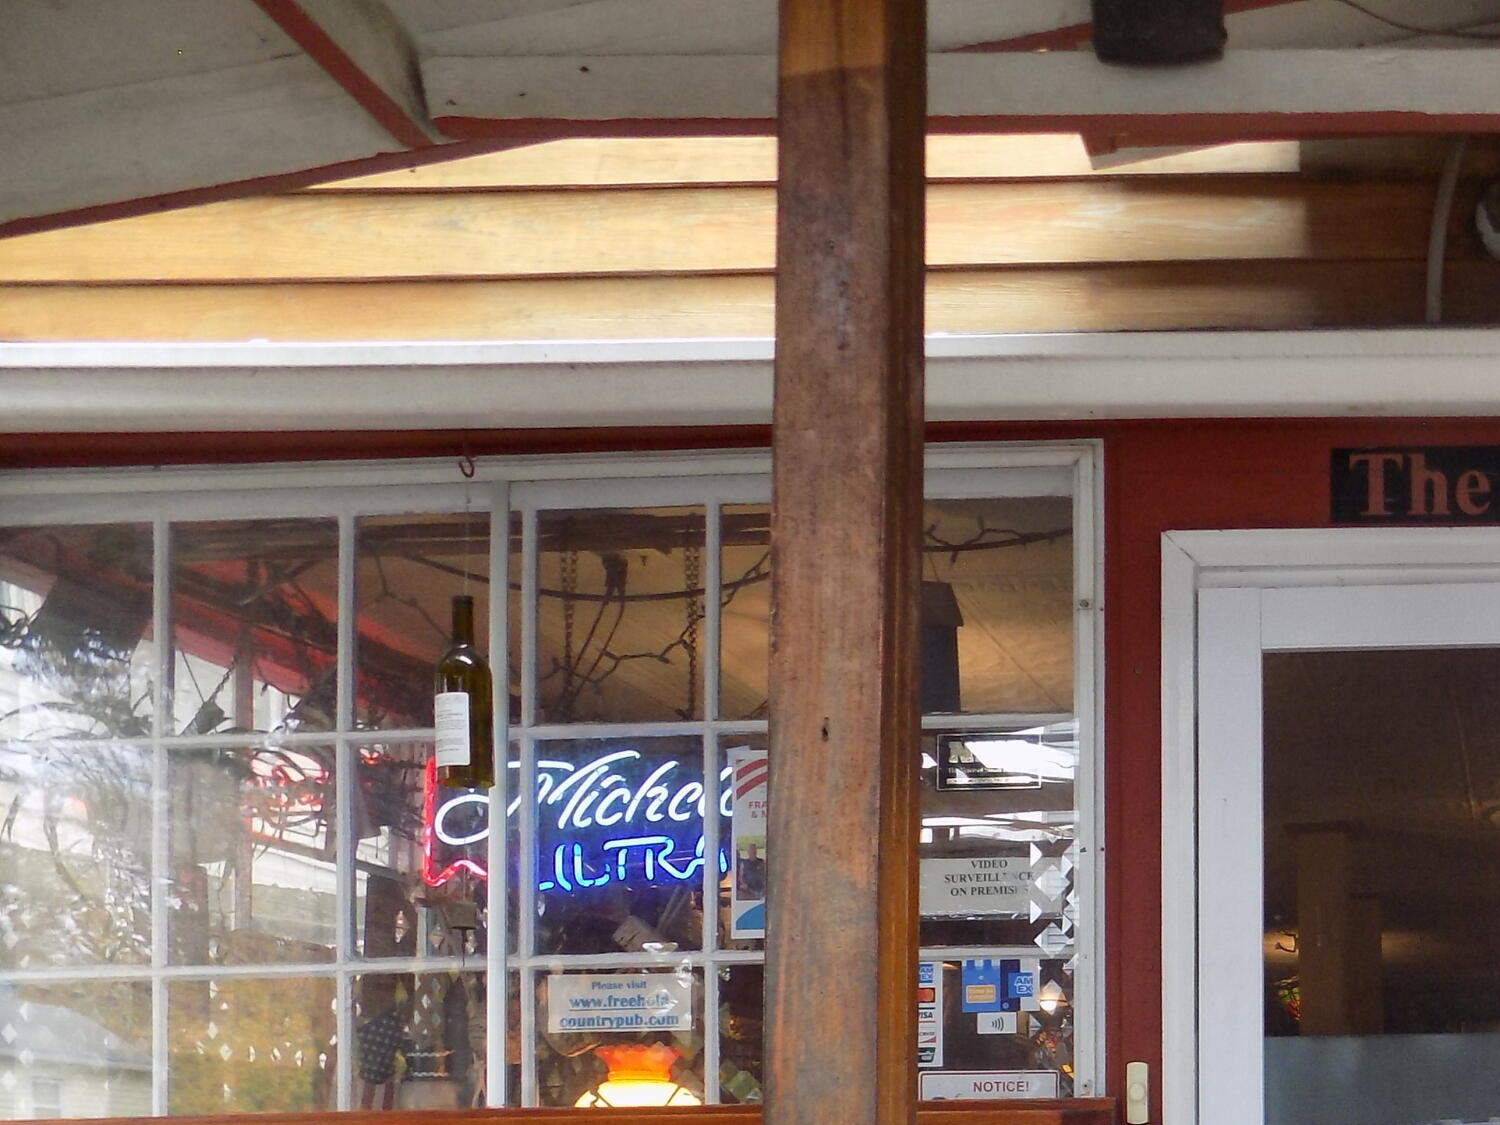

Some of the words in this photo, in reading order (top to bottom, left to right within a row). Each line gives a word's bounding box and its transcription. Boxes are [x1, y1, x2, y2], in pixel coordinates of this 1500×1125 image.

[1350, 453, 1491, 516] The
[971, 859, 1008, 869] VIDEO
[944, 871, 1033, 884] SURVEILLCE
[951, 887, 967, 896] ON
[591, 981, 623, 989] Please
[627, 981, 647, 989] visit
[560, 1014, 679, 1028] countrypub.com
[973, 1081, 1029, 1092] NOTICE!
